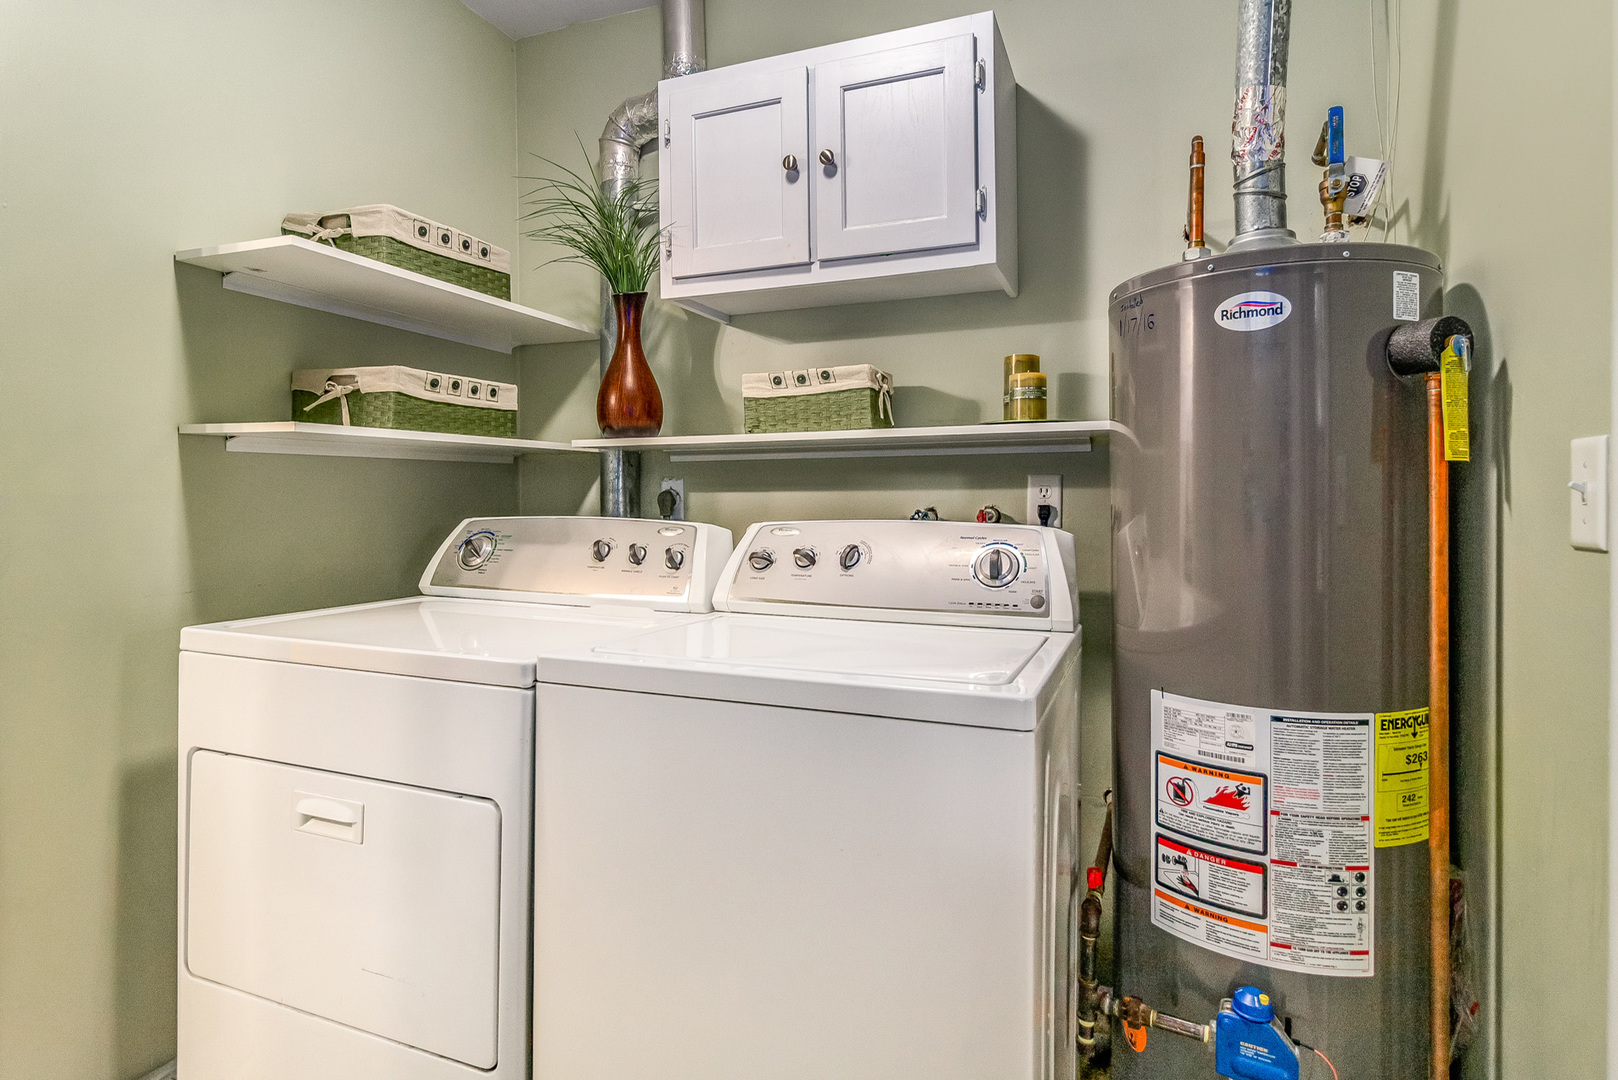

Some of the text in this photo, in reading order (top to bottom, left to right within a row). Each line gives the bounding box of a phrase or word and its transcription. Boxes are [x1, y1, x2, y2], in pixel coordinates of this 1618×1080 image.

[1347, 174, 1363, 197] STOP
[1221, 301, 1283, 321] Richmond
[1405, 750, 1428, 765] $263
[1191, 765, 1230, 779] WARNING
[1401, 793, 1416, 803] 242
[1193, 851, 1227, 866] DANGER
[1193, 906, 1229, 923] WARNING
[1240, 1041, 1269, 1053] CAUTION
